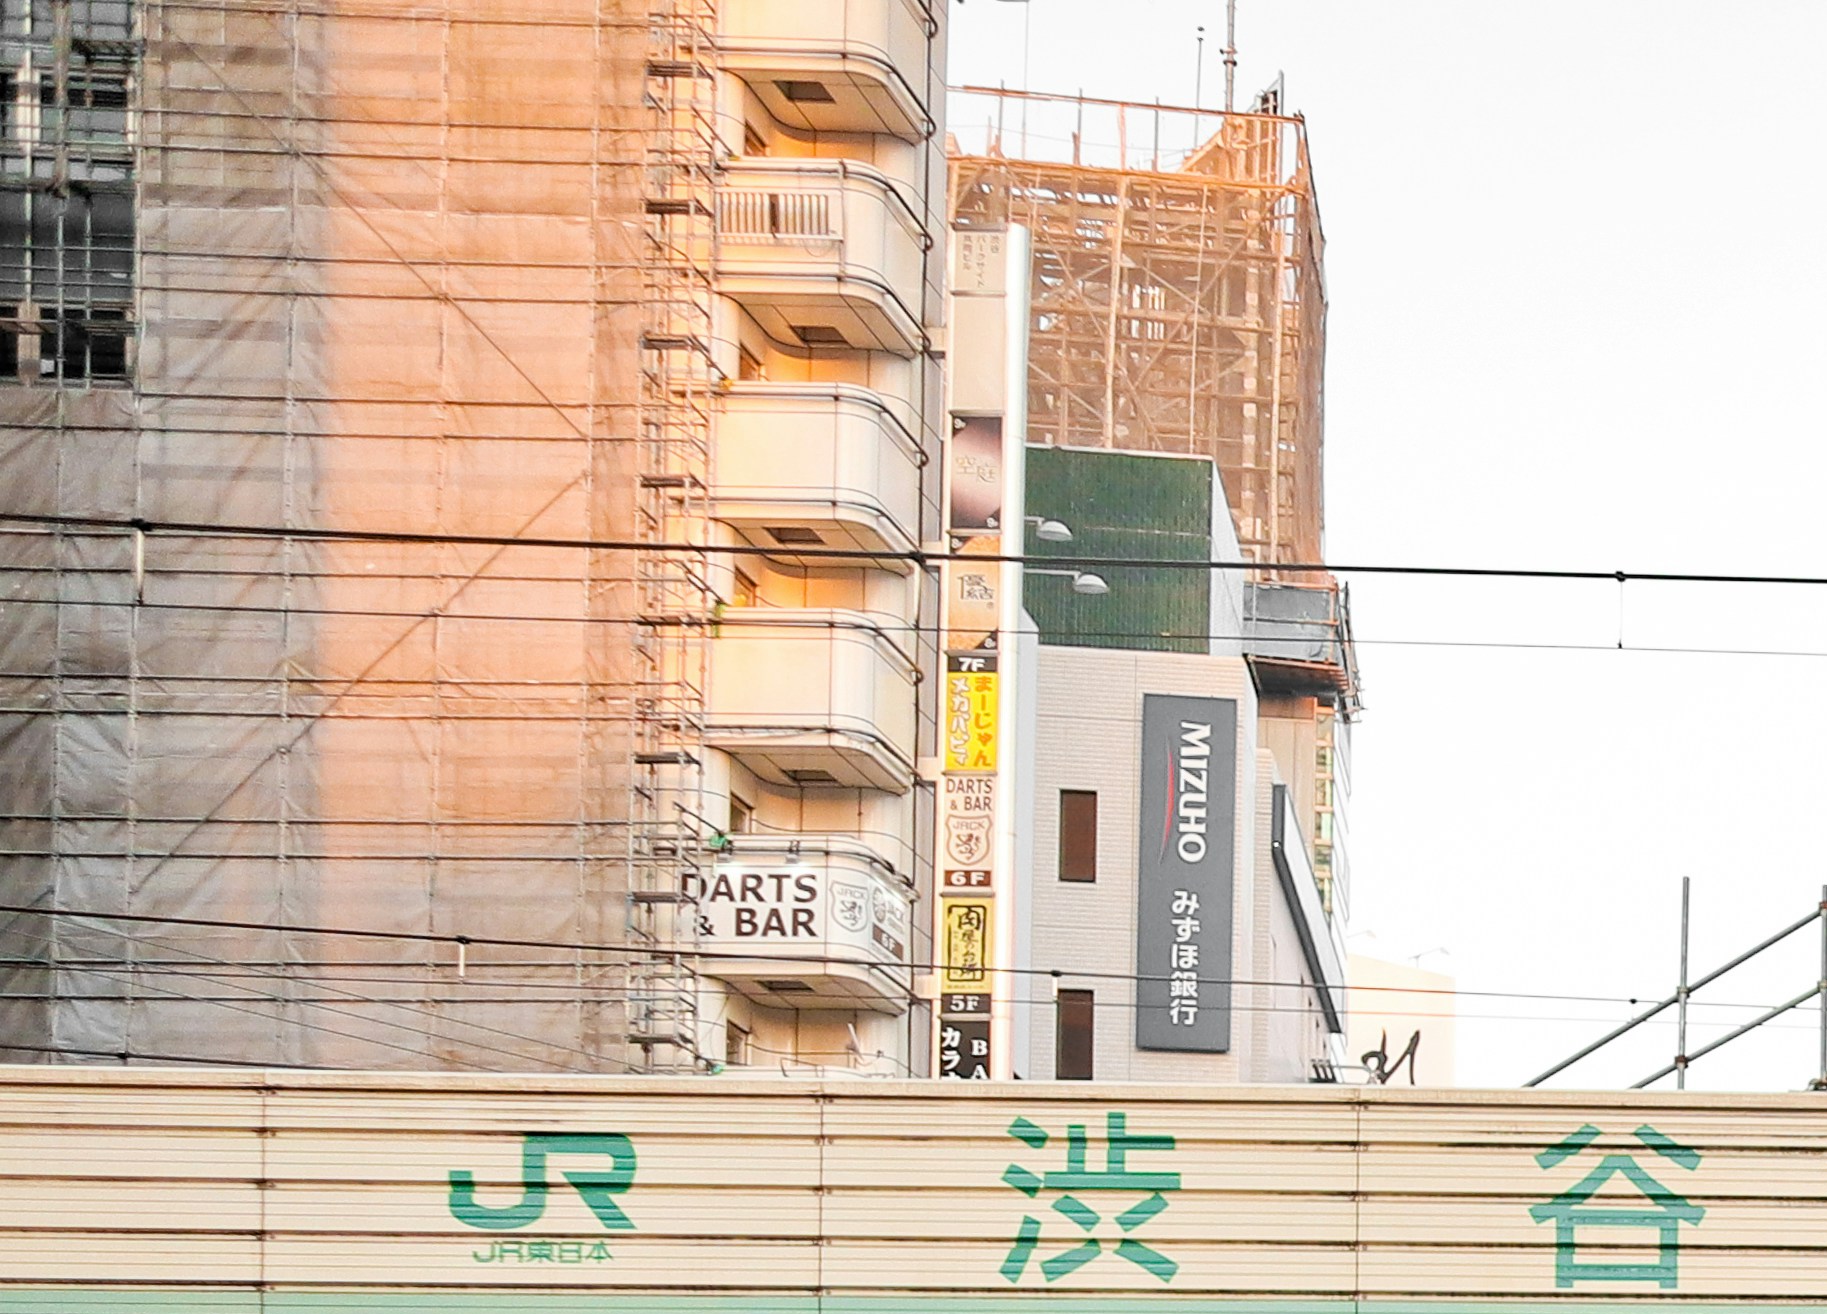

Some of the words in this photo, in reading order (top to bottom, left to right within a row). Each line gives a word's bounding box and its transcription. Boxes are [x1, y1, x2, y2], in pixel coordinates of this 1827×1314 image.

[958, 657, 985, 672] 7F
[974, 676, 992, 767] まーじゃん
[946, 778, 992, 795] DARTS
[1178, 720, 1212, 864] MIZUHO
[950, 799, 957, 811] &
[964, 796, 992, 811] BAR
[681, 873, 818, 904] DARTS
[950, 871, 985, 886] 6F
[735, 907, 819, 938] BAR
[1170, 890, 1201, 1026] みずほ銀行
[951, 995, 979, 1012] 5F
[448, 1132, 637, 1230] JR
[471, 1238, 614, 1266] JR東日本
